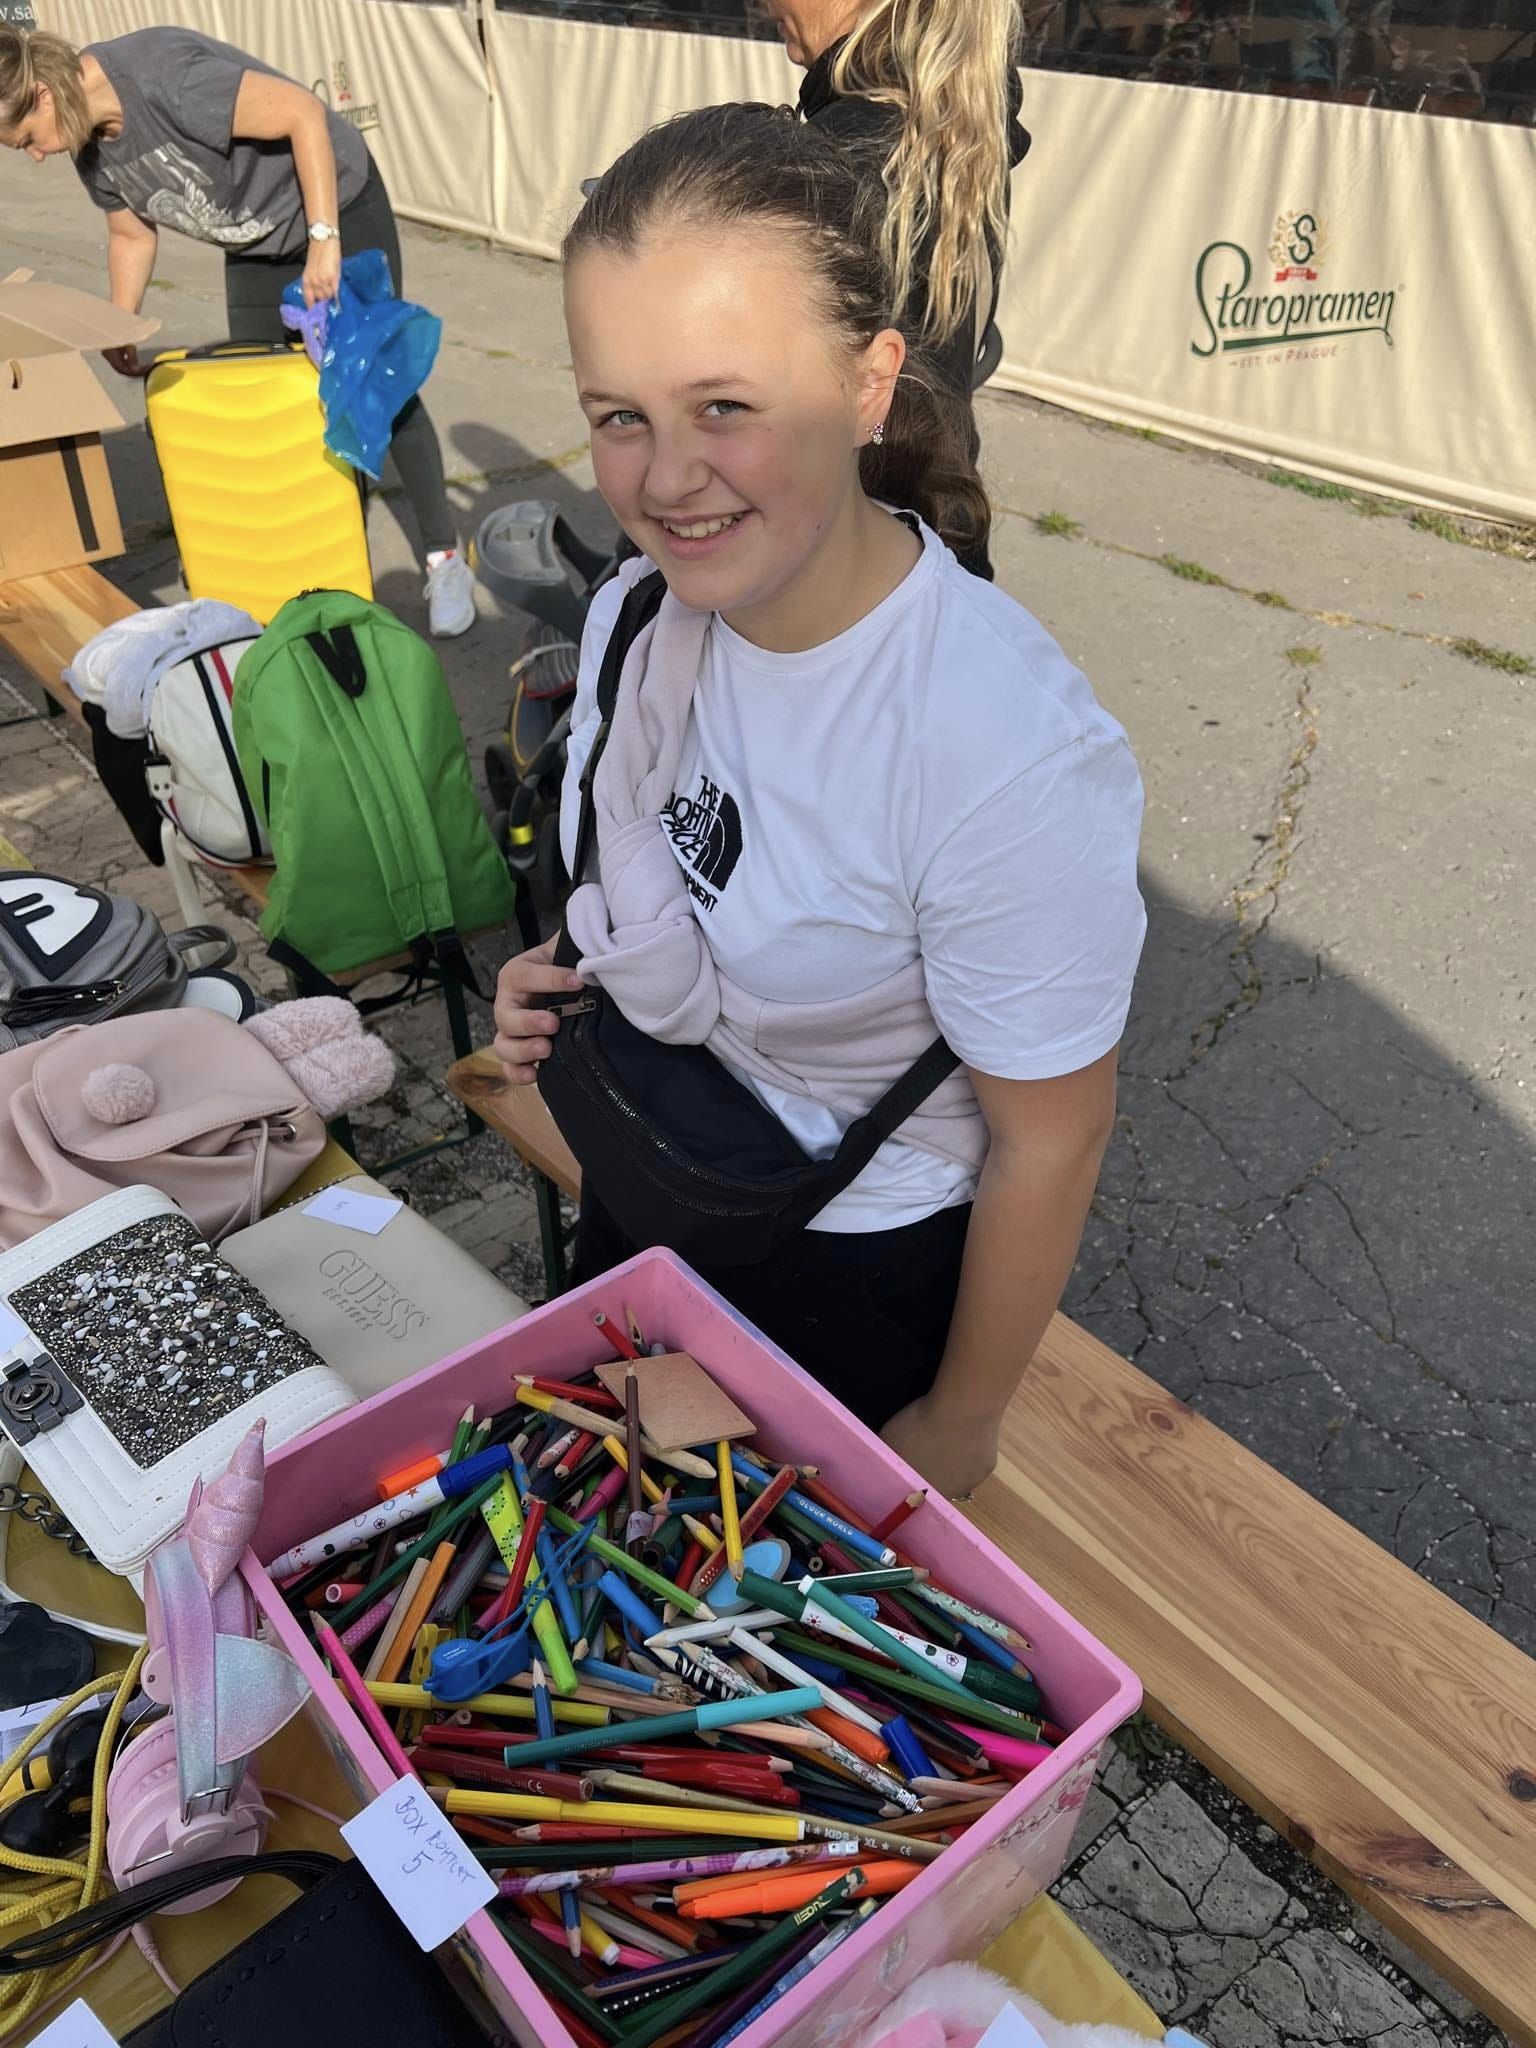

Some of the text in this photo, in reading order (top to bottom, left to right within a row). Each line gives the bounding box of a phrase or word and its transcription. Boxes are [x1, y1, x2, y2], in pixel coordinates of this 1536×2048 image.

[1191, 241, 1395, 356] Staropramen
[698, 775, 721, 813] THE
[319, 1249, 431, 1340] GUESS
[395, 1795, 429, 1836] BOX
[824, 1827, 850, 1841] KIDS
[863, 1837, 878, 1849] XL
[401, 1850, 435, 1874] 5
